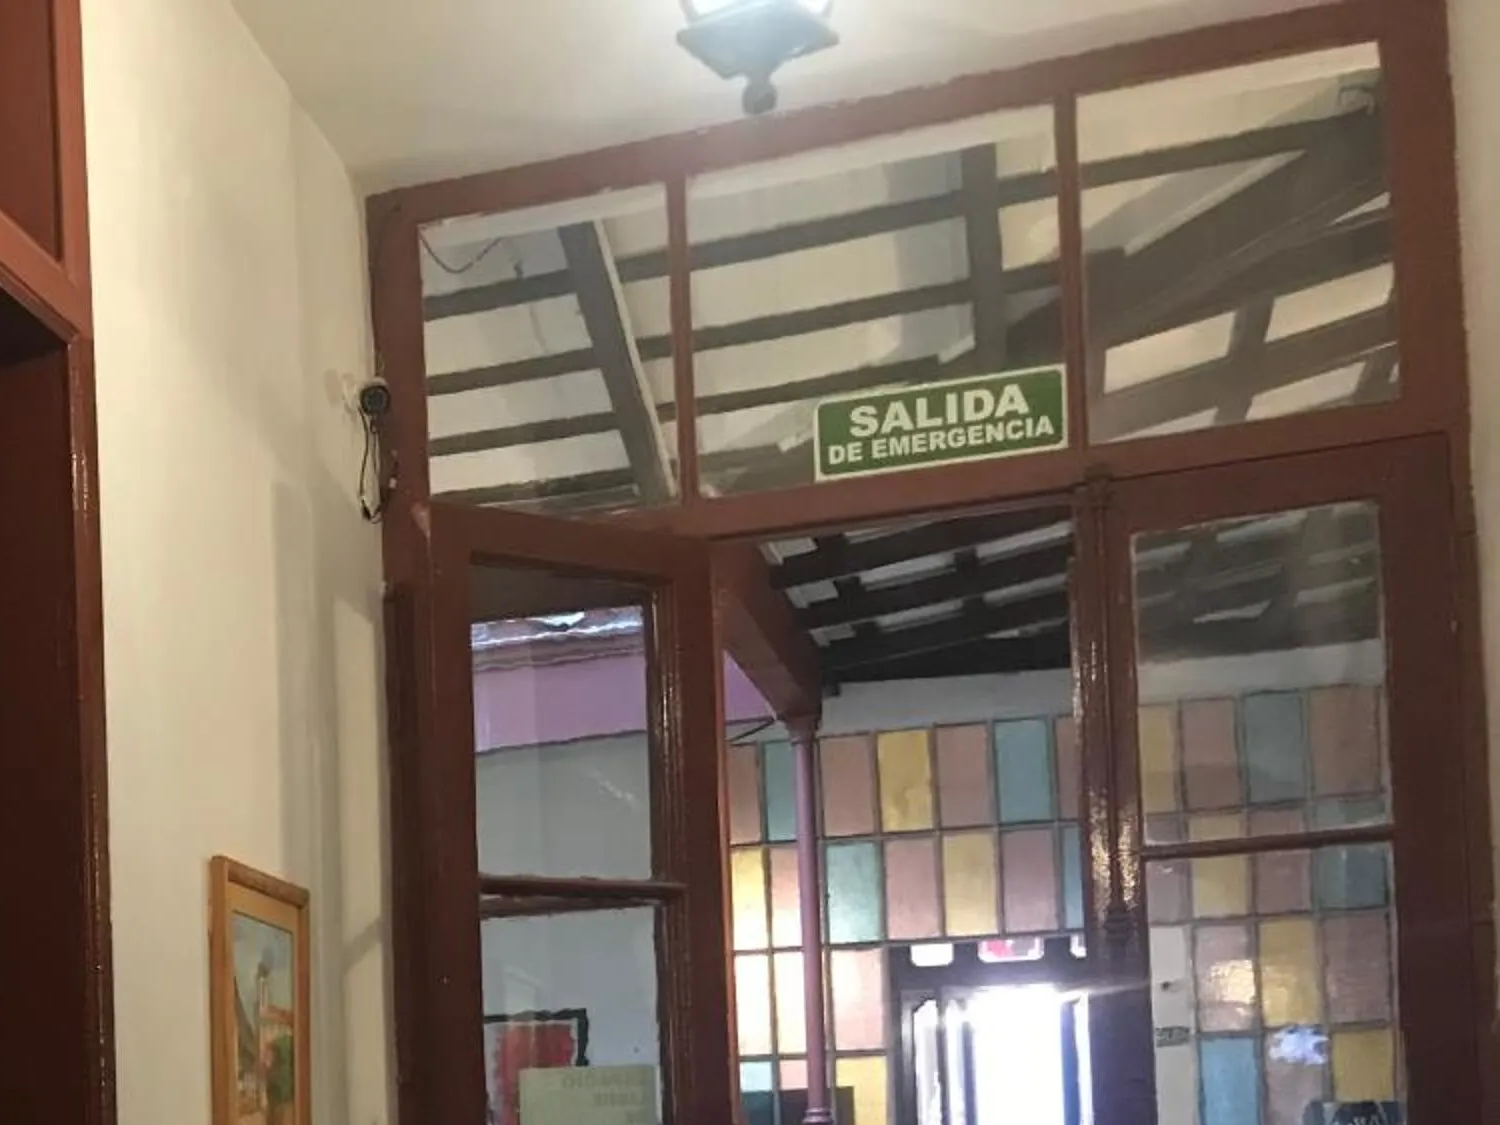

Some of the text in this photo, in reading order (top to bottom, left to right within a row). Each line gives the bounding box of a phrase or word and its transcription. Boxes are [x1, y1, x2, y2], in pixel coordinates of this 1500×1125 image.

[850, 384, 1029, 437] SALIDA
[828, 415, 1054, 465] DE EMERGENCIA
